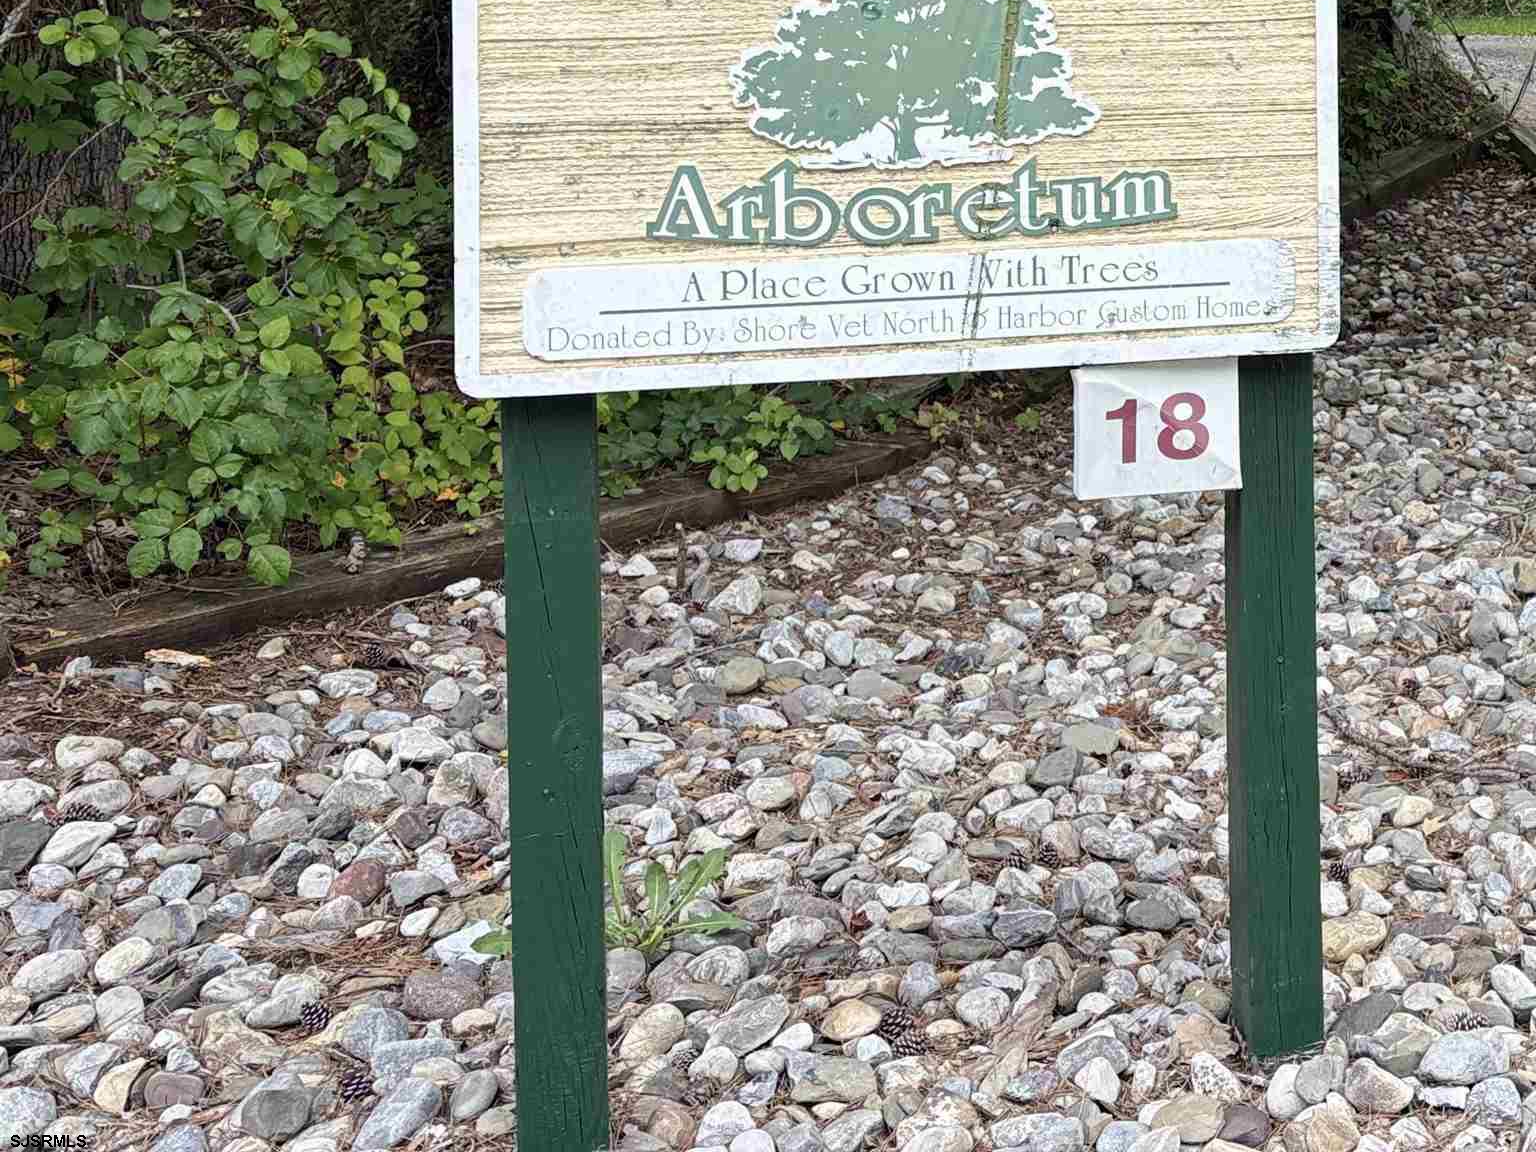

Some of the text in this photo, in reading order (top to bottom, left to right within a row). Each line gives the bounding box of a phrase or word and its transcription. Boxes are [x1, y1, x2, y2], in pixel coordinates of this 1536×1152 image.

[652, 160, 1171, 242] Arboretum
[681, 254, 1160, 303] A Place Grown With Trees
[547, 320, 672, 353] Donated
[734, 315, 818, 344] Shore
[826, 312, 874, 339] Vet
[883, 307, 954, 337] North
[998, 302, 1088, 330] Harbor
[1196, 295, 1280, 320] Homes
[1104, 391, 1210, 465] 18
